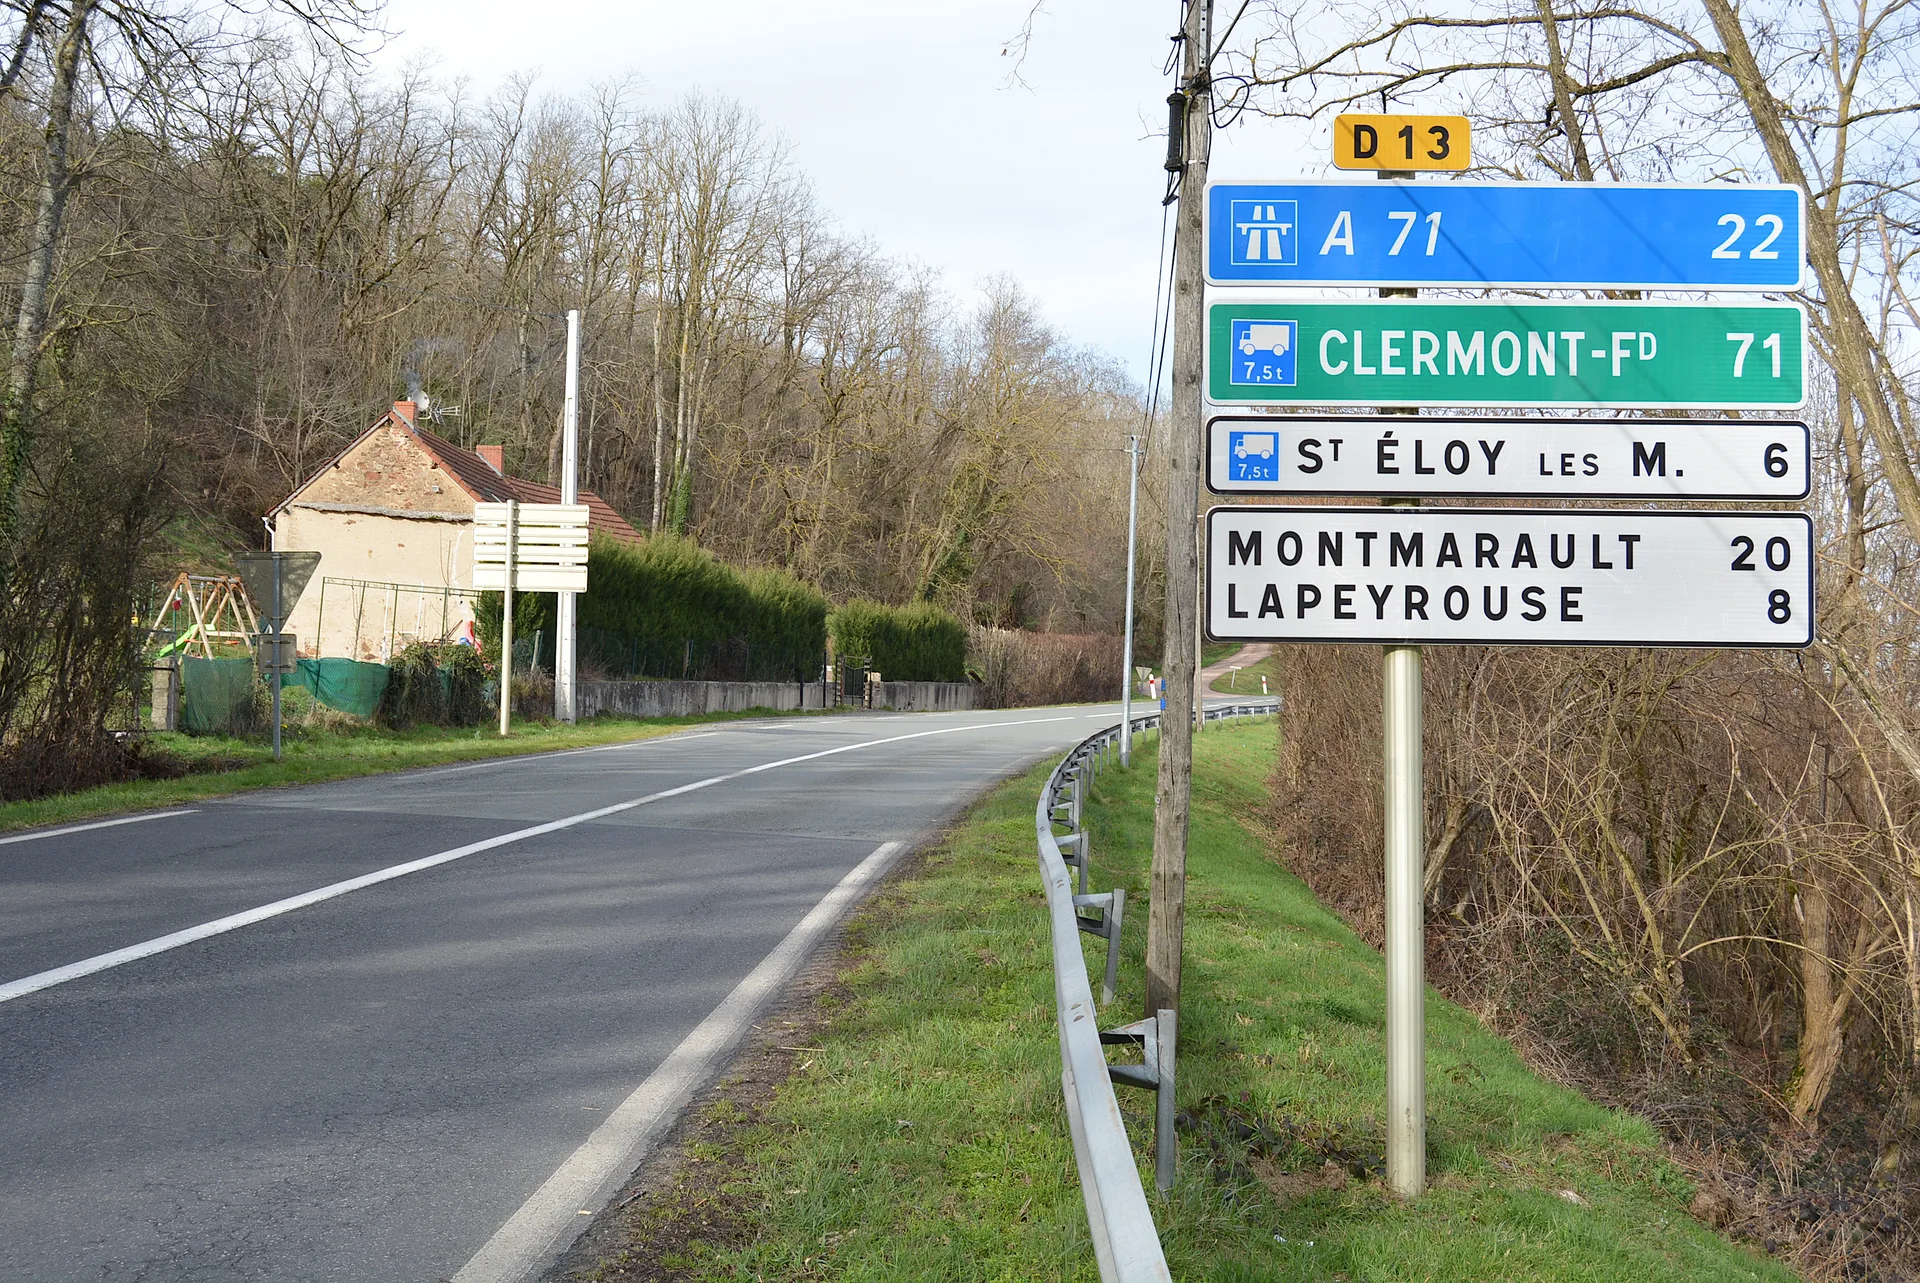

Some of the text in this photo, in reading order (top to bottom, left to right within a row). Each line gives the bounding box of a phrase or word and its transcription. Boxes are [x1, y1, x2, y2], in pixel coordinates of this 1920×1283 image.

[1353, 124, 1450, 160] D 13
[1318, 210, 1784, 260] A 71 22
[1726, 332, 1781, 378] 71
[1297, 430, 1789, 478] ST ÉLOY LES M. 6
[1228, 530, 1791, 572] MONTMARAULT 20
[1227, 583, 1792, 625] LAPEYROUSE 8
